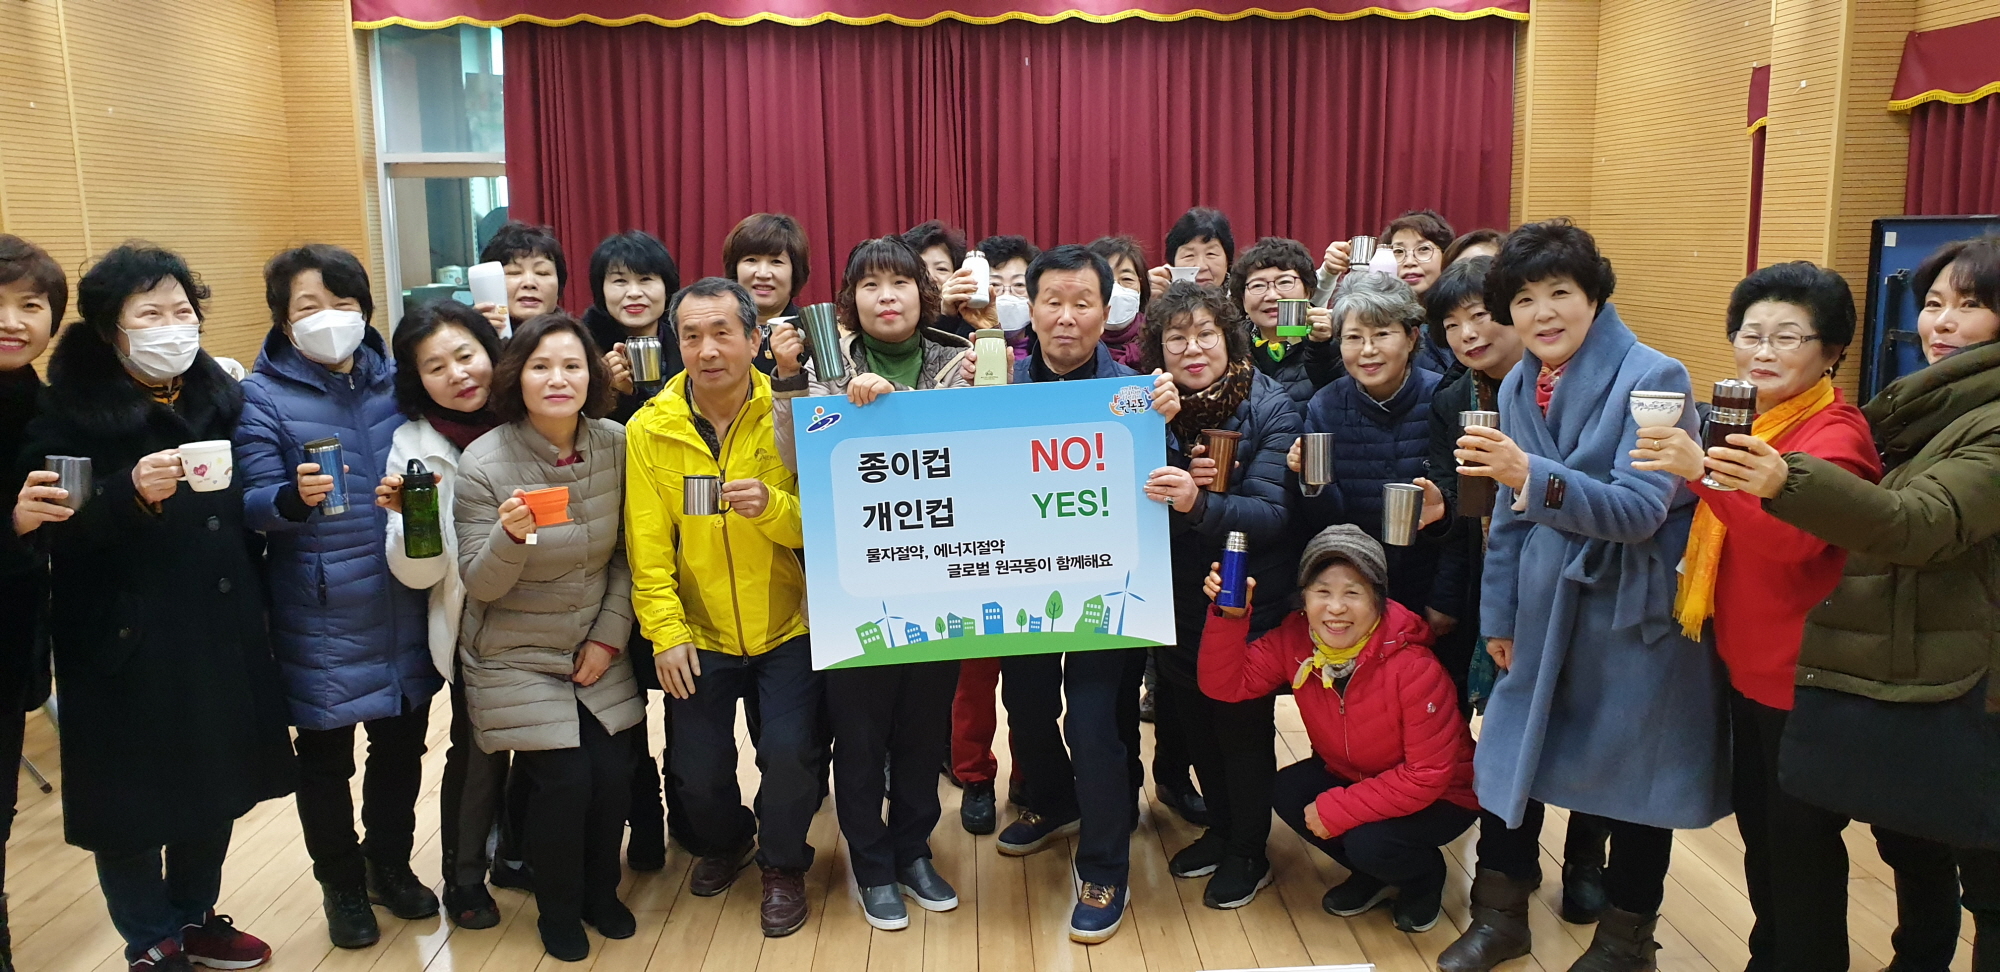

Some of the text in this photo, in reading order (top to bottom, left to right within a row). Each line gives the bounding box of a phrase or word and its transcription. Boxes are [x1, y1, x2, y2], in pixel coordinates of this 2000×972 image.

[1119, 398, 1145, 414] 원곡동
[857, 432, 1105, 483] 종이컵 NO!
[862, 486, 1109, 532] 개인컵 YES!
[866, 538, 1005, 563] 물자절약, 에너지절약
[946, 552, 1113, 579] 글로벌 원곡동이 함께해요
